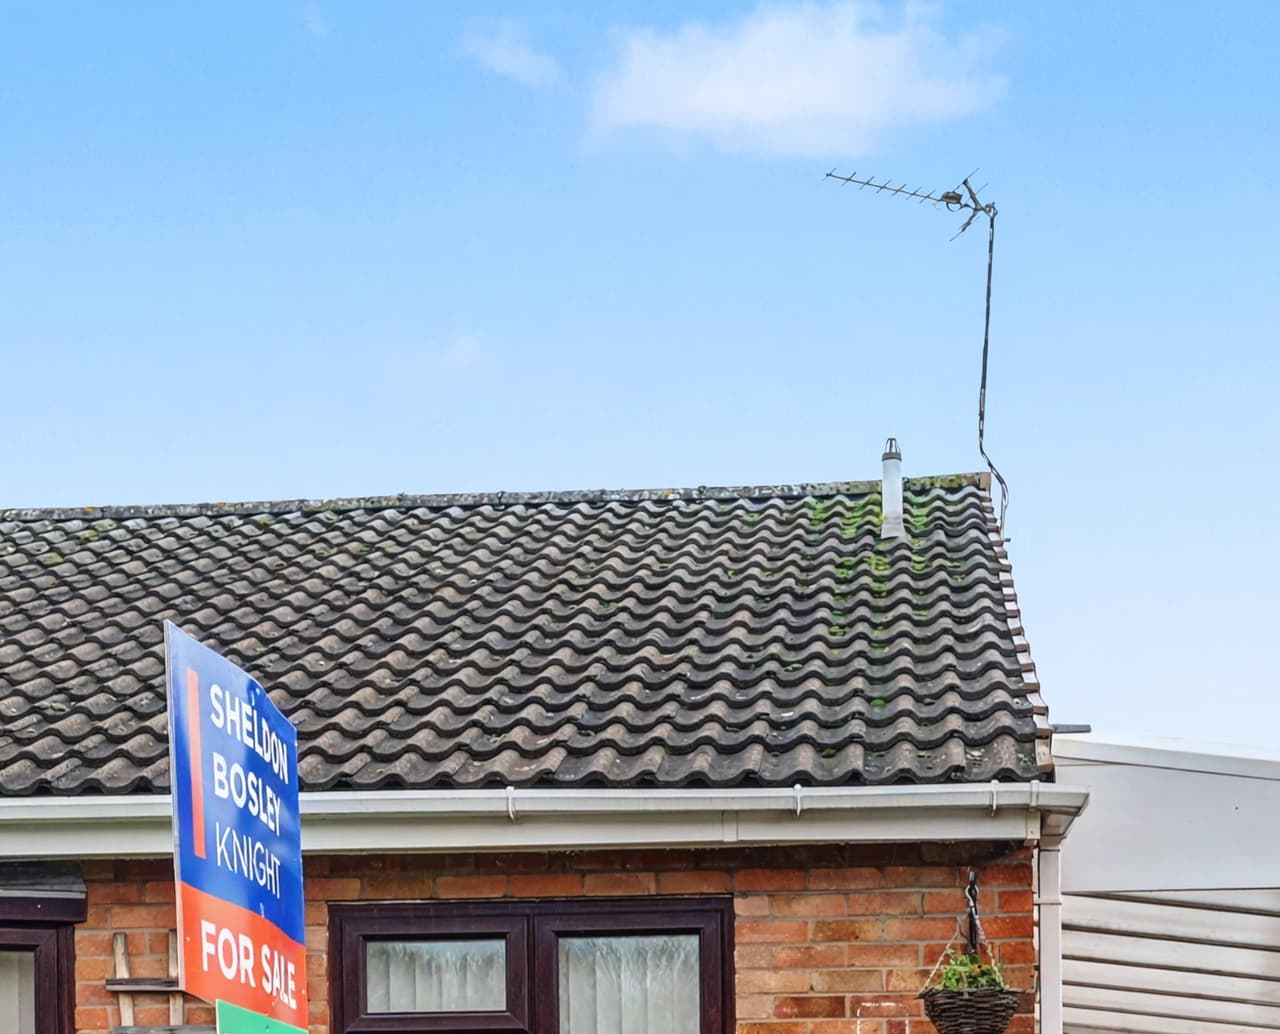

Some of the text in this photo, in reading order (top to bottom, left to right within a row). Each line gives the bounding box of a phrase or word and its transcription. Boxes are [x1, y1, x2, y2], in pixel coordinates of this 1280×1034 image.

[210, 684, 289, 784] SHELDON
[212, 752, 281, 837] BOSLEY
[215, 822, 280, 899] KNIGHT
[201, 920, 297, 1009] FOR SALE
